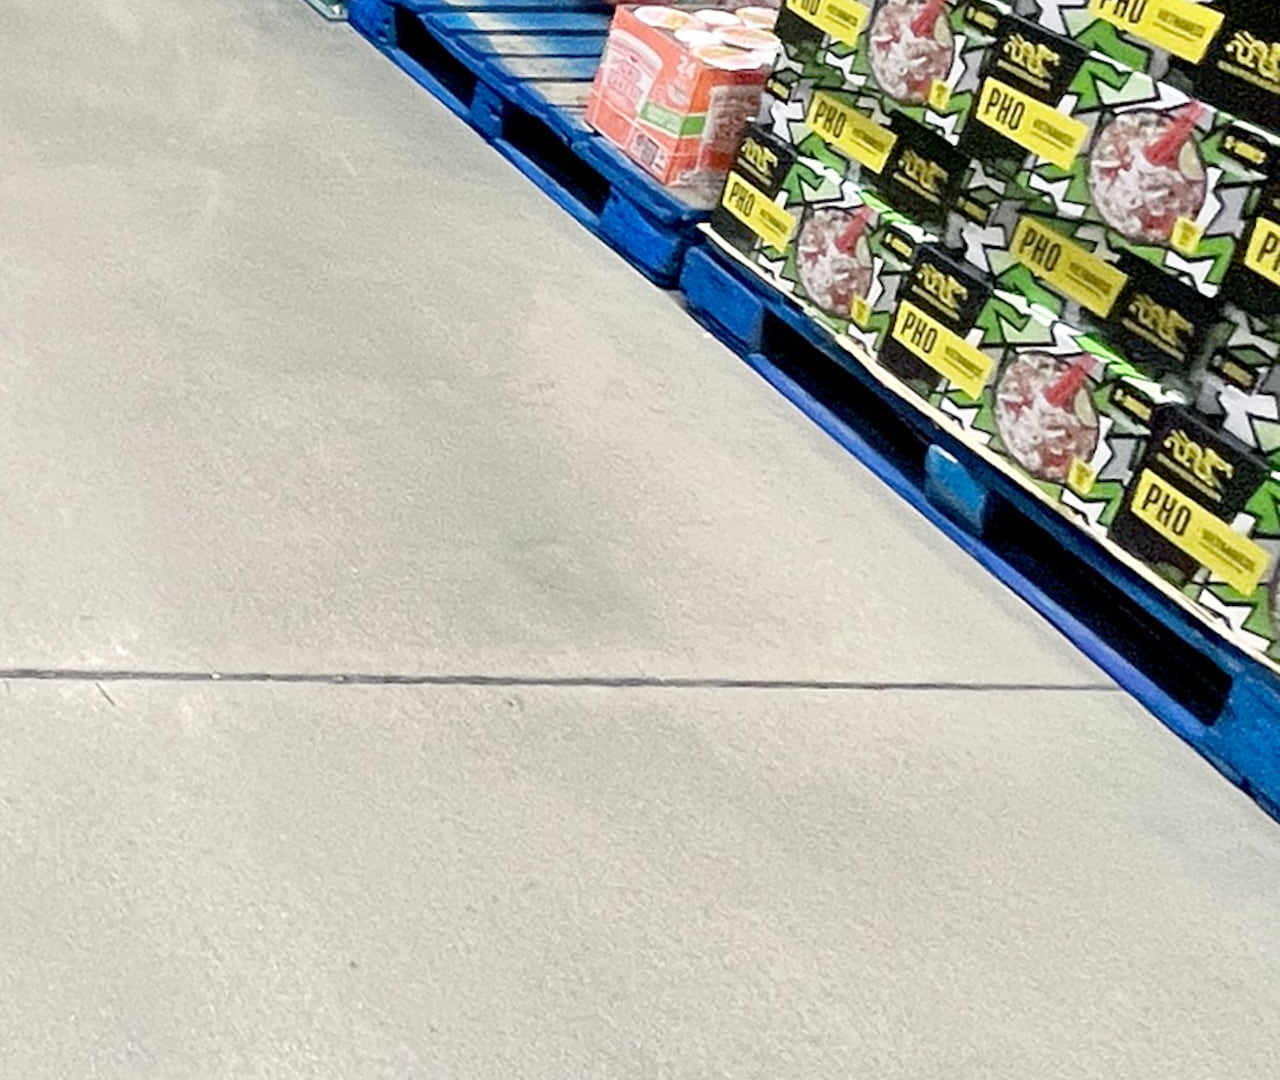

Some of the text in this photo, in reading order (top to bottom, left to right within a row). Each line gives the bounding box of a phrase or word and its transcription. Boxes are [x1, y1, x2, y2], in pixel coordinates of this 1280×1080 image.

[813, 101, 846, 139] PHO
[985, 86, 1026, 132] PHO
[728, 181, 756, 218] PHO
[1017, 227, 1062, 273] PHO
[900, 311, 939, 354] PHO
[1140, 482, 1193, 537] PHO
